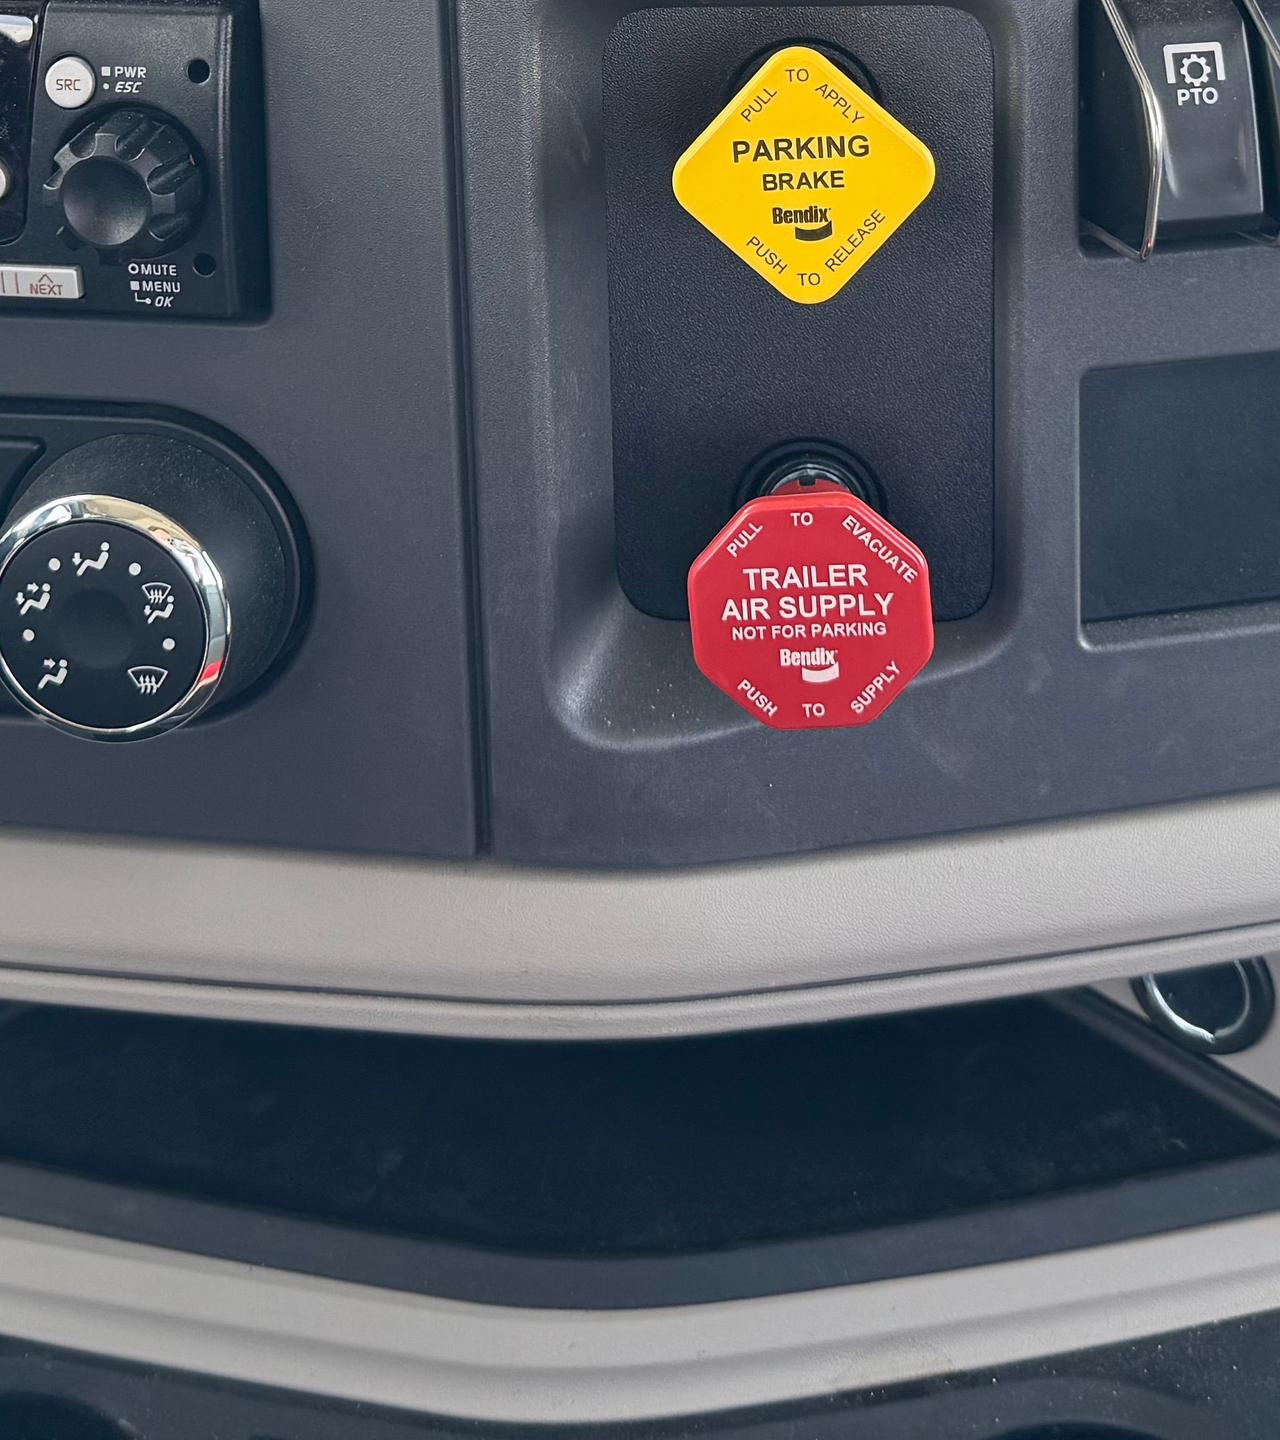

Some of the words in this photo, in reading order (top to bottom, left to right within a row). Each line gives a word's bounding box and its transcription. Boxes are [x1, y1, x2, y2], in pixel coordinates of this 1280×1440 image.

[114, 66, 147, 78] PWR
[56, 79, 81, 91] SRC
[114, 81, 142, 93] ESC
[741, 88, 777, 122] PULL
[786, 68, 809, 82] TO
[815, 83, 864, 124] APPLY
[1177, 87, 1218, 106] PTO
[732, 135, 870, 163] PARKING
[762, 170, 845, 192] BRAKE
[772, 206, 829, 225] Bendix
[746, 236, 788, 274] PUSH
[797, 273, 821, 286] TO
[825, 209, 886, 272] RELEASE
[140, 264, 177, 276] MUTE
[29, 284, 64, 296] NEXT
[142, 280, 180, 293] MENU
[154, 296, 174, 307] OK
[726, 523, 764, 558] PULL
[790, 512, 814, 526] TO
[842, 515, 918, 584] EVACUATE
[743, 564, 868, 590] TRAILER
[722, 598, 770, 621] AIR
[779, 592, 894, 619] SUPPLY
[732, 626, 767, 640] NOT
[772, 624, 806, 639] FOR
[811, 622, 887, 637] PARKING
[780, 648, 837, 667] Bendix
[737, 679, 778, 716] PUSH
[802, 704, 825, 718] TO
[851, 661, 902, 714] SUPPLY
